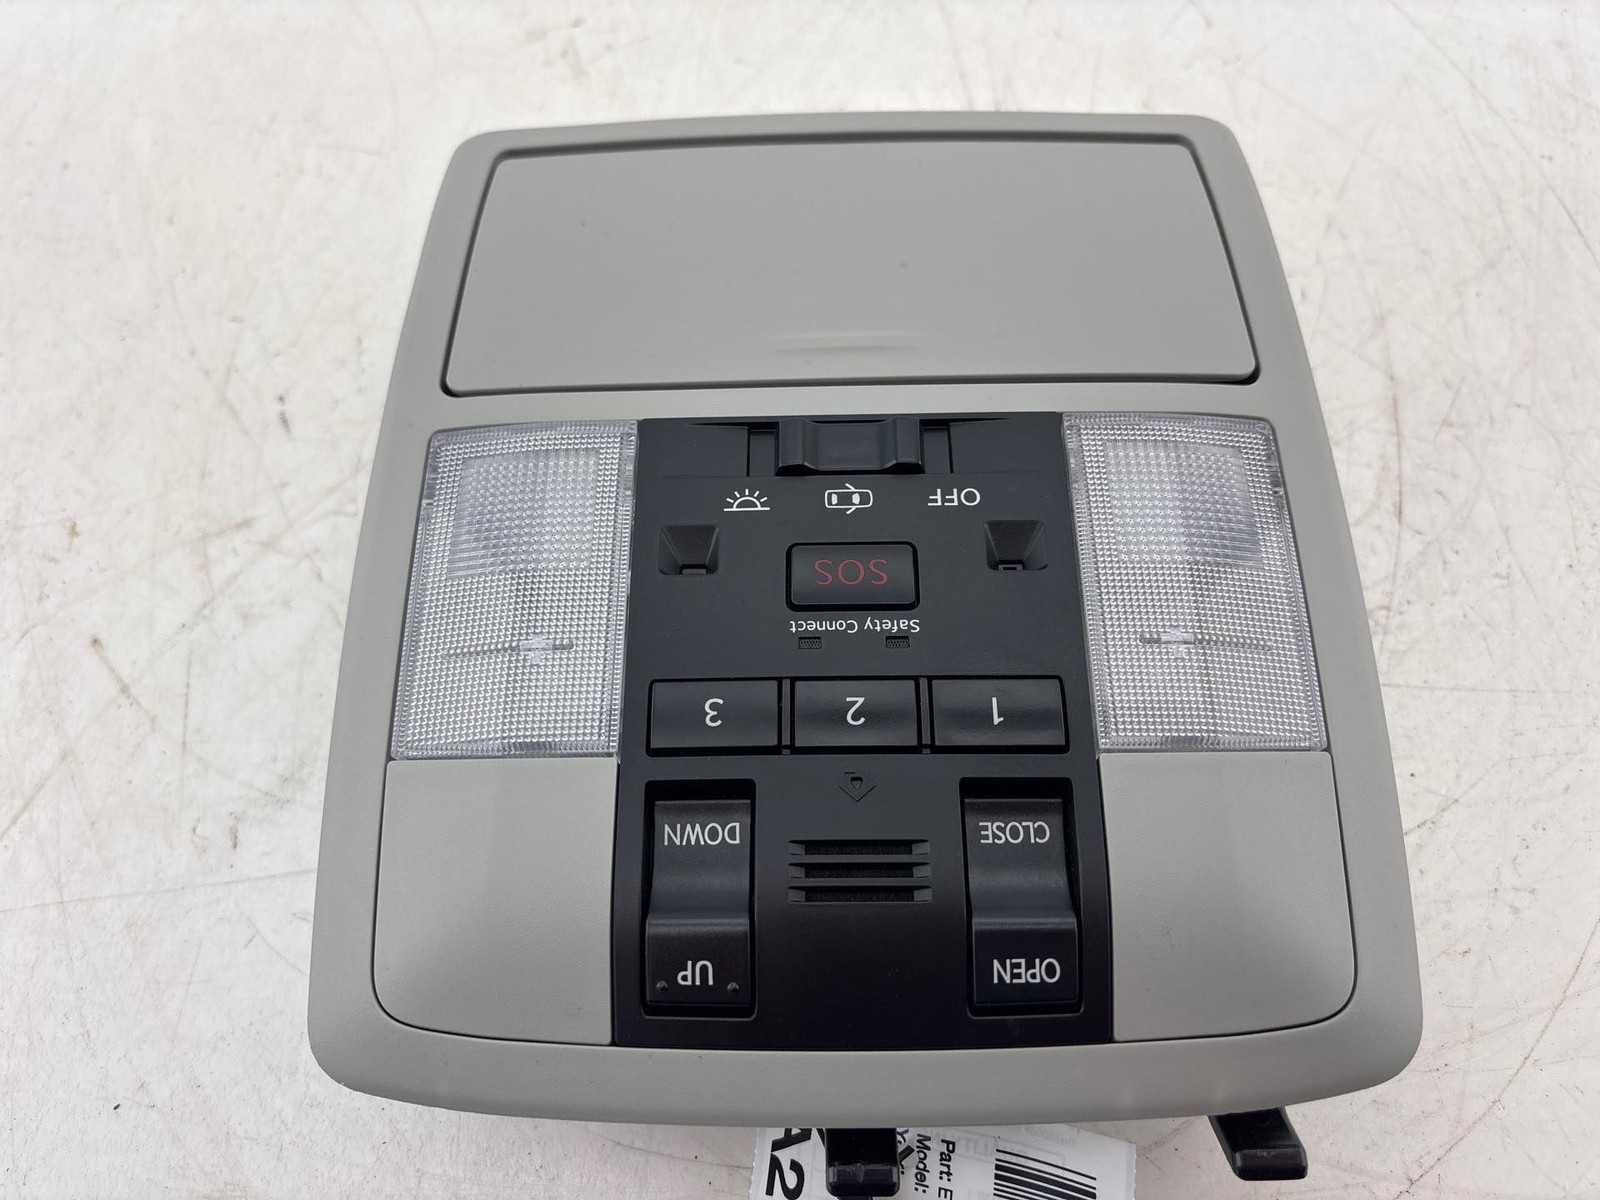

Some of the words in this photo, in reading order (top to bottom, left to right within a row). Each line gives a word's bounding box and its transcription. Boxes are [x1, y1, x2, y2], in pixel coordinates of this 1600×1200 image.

[927, 487, 981, 506] OFF
[814, 559, 888, 585] SOS
[789, 618, 859, 633] Connect
[863, 616, 920, 633] Safety
[704, 697, 724, 727] 3
[845, 696, 866, 725] 2
[991, 696, 1004, 726] 1
[664, 822, 741, 846] DOWN
[978, 821, 1050, 844] CLOSE
[677, 960, 714, 986] UP
[993, 957, 1061, 984] OPEN
[914, 1133, 931, 1193] Model:
[939, 1138, 956, 1182] Part:
